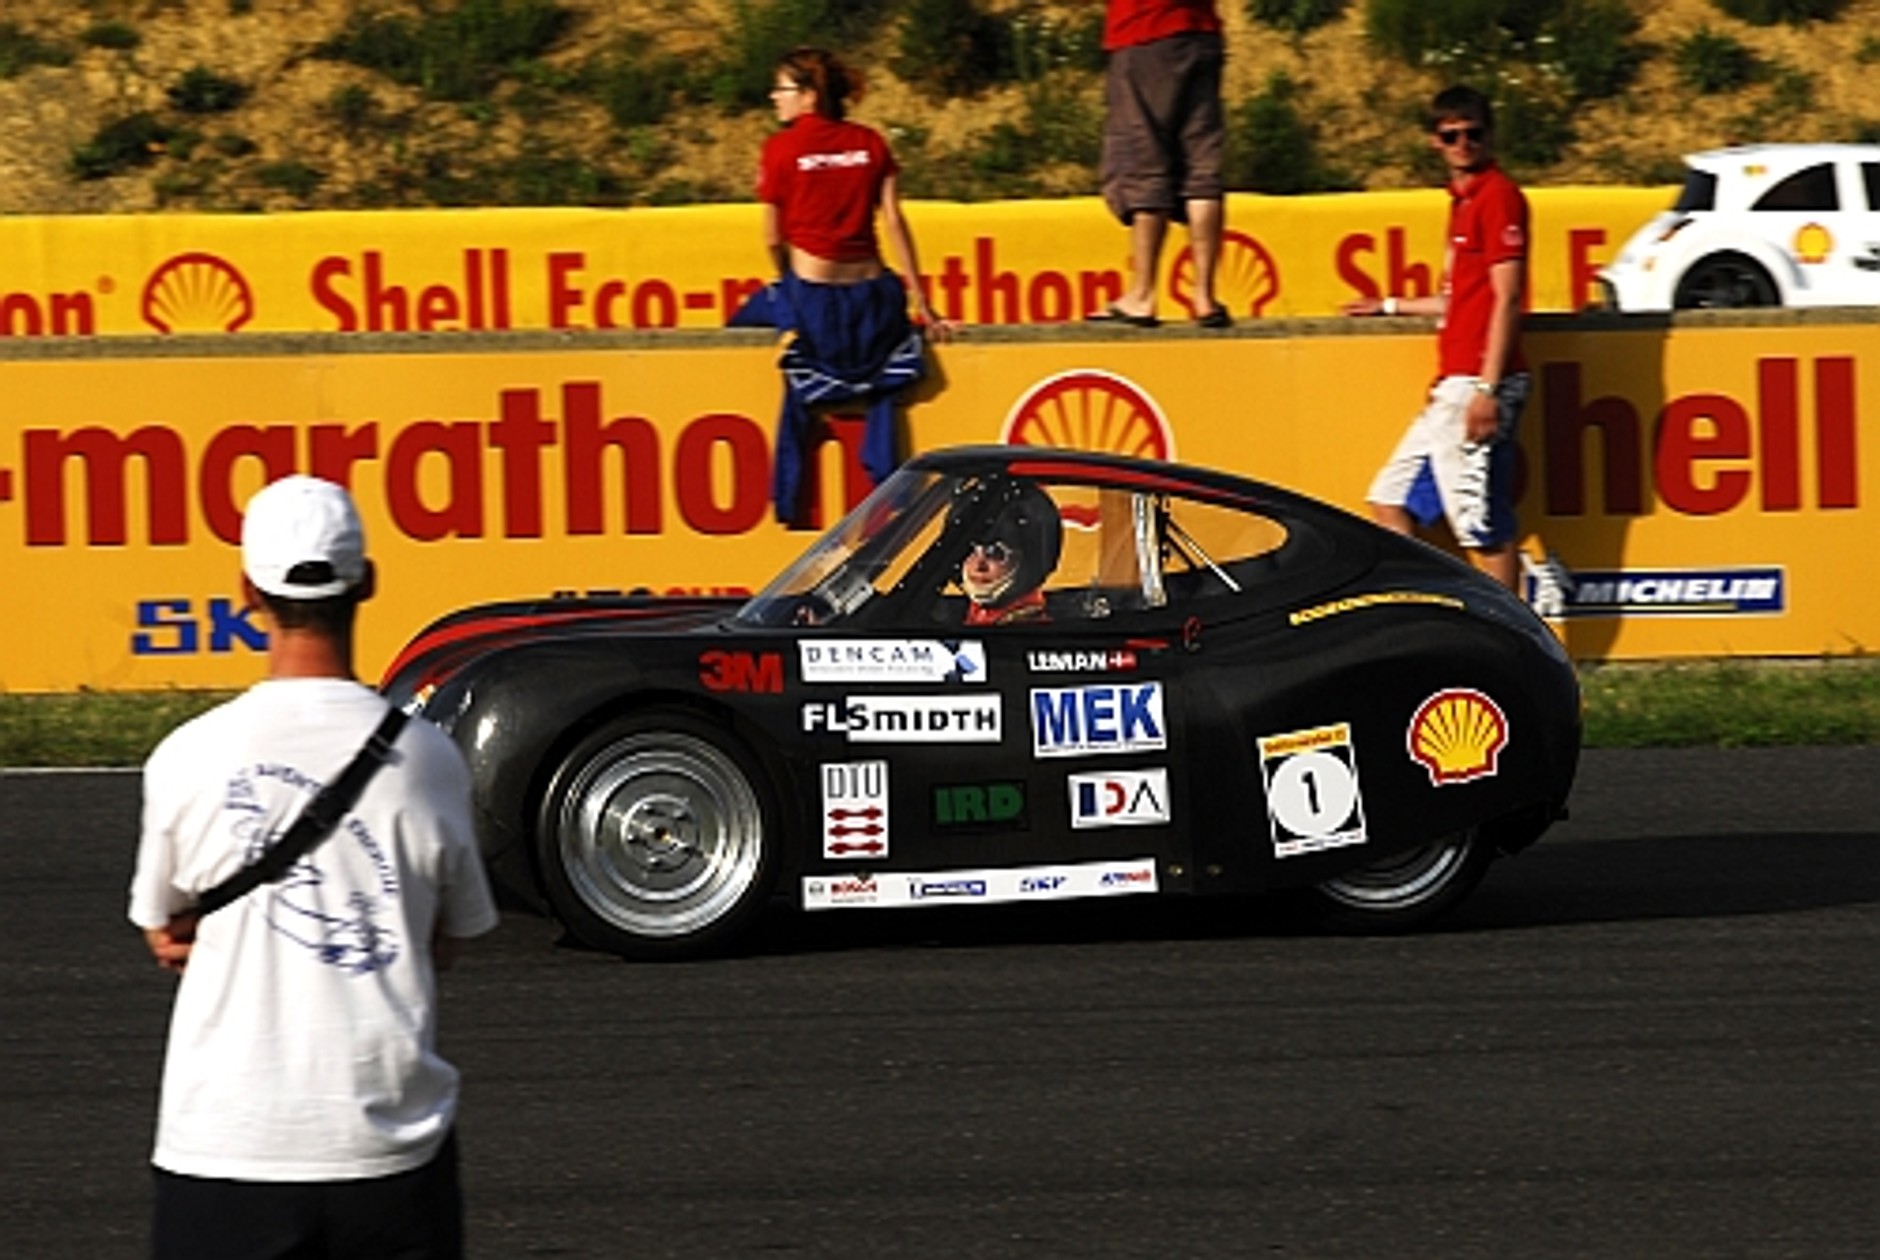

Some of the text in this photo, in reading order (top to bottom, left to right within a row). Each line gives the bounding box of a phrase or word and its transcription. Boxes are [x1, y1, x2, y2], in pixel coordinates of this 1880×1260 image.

[310, 248, 510, 332] Shell
[1516, 356, 1859, 517] hell
[1576, 578, 1777, 604] MICHELIN
[131, 600, 270, 654] SK
[699, 650, 783, 694] 3M
[806, 646, 933, 663] DENCAM
[1034, 684, 1163, 746] MEK
[827, 764, 881, 799] DTU
[935, 784, 1024, 824] IRD
[1302, 770, 1322, 816] 1
